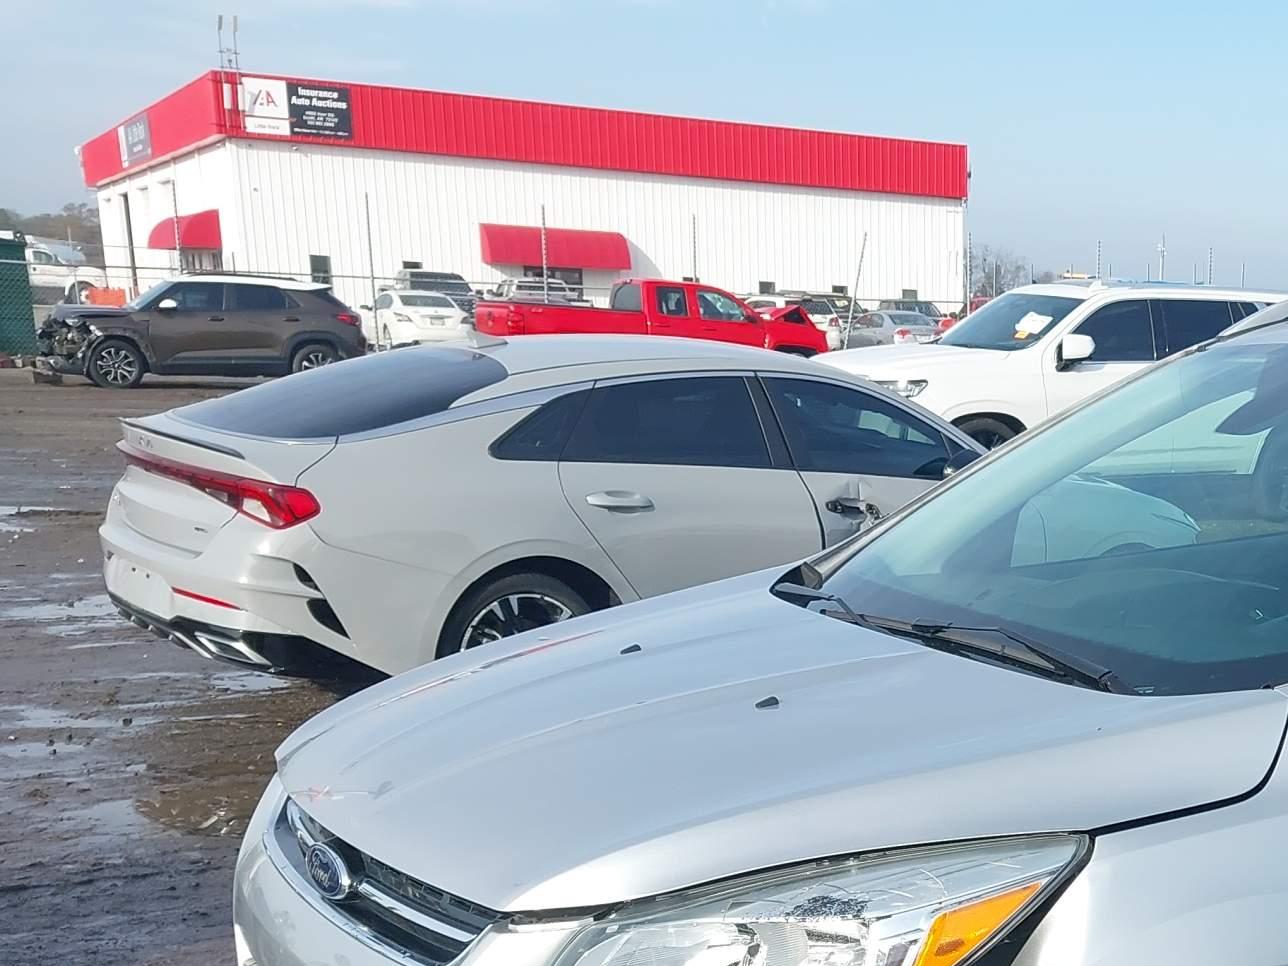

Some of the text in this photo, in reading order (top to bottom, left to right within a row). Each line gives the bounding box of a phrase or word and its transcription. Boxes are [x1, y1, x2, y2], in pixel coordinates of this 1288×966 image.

[298, 87, 338, 99] Insurance
[291, 96, 347, 109] Auto Auctions
